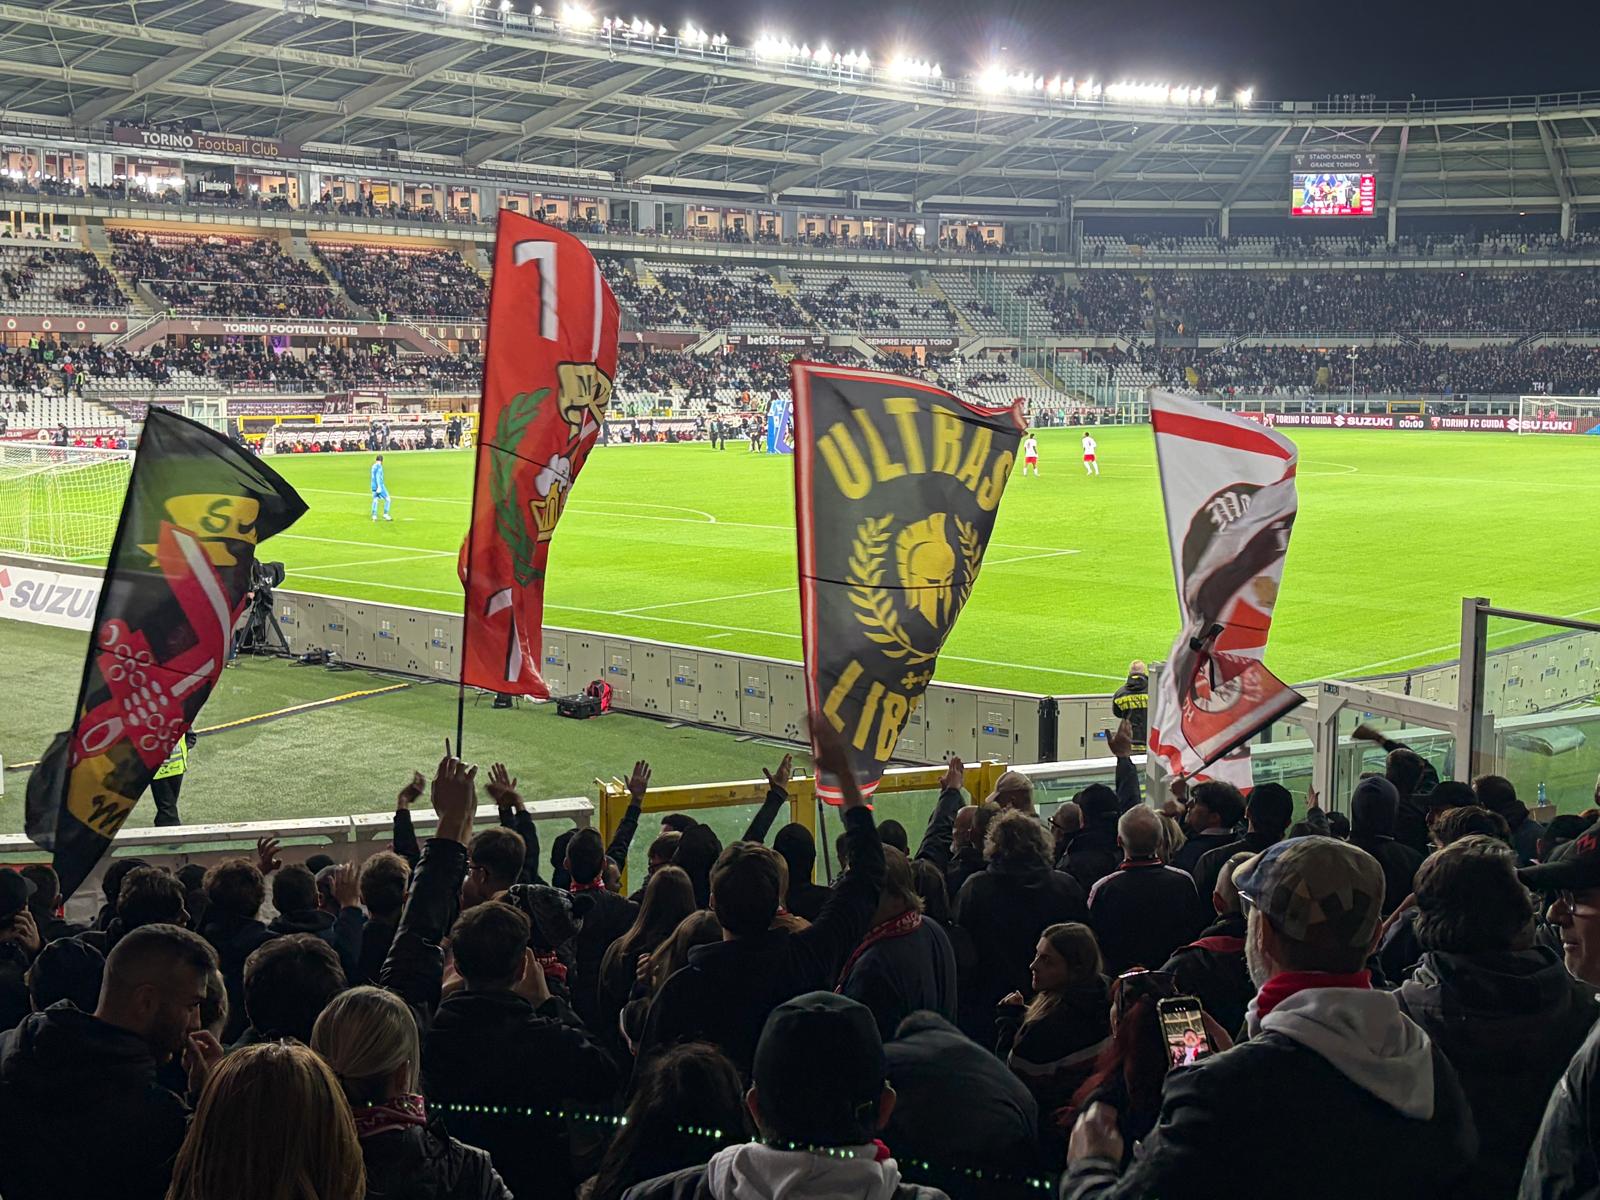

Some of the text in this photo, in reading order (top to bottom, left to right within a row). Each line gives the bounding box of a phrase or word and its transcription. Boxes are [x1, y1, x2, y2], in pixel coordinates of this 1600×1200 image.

[141, 131, 279, 156] TORINO Football Club
[223, 323, 358, 336] TORINO FOOTBALL CLUB
[747, 334, 780, 345] bet365
[780, 337, 806, 346] Scores
[865, 337, 953, 346] SEMPRE FORZA TORO
[1275, 414, 1300, 424] TORINO
[1300, 414, 1310, 424] FC
[1346, 416, 1393, 427] SUZUKI
[1398, 419, 1424, 429] 00:00
[1442, 418, 1573, 431] TORINO FC GUIDA SUZUKI
[817, 397, 1014, 512] ULTRAS
[822, 659, 919, 763] LIB
